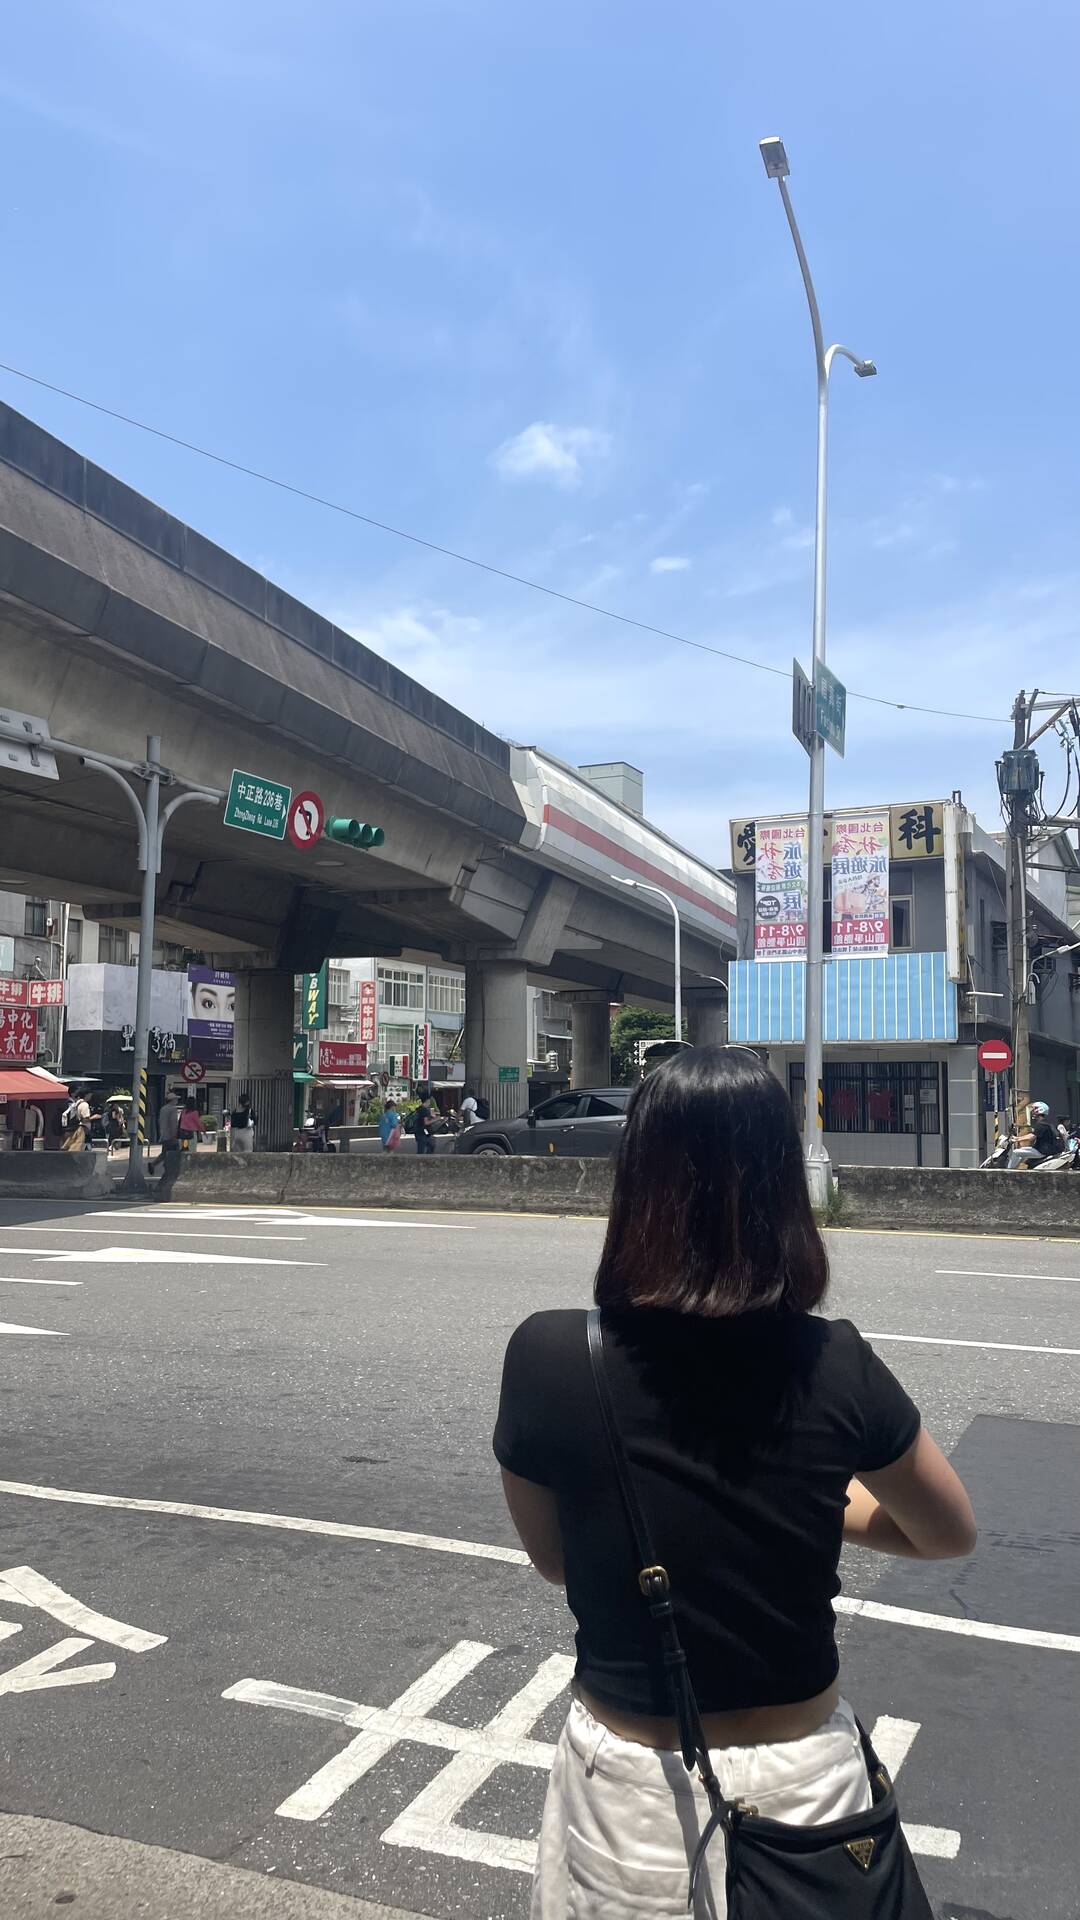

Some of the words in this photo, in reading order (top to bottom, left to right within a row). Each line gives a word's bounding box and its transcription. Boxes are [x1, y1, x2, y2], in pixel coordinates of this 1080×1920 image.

[238, 782, 283, 811] 中正路236巷
[32, 983, 62, 1004] 牛排
[308, 973, 320, 1025] BWAY
[0, 1031, 33, 1054] 貢丸
